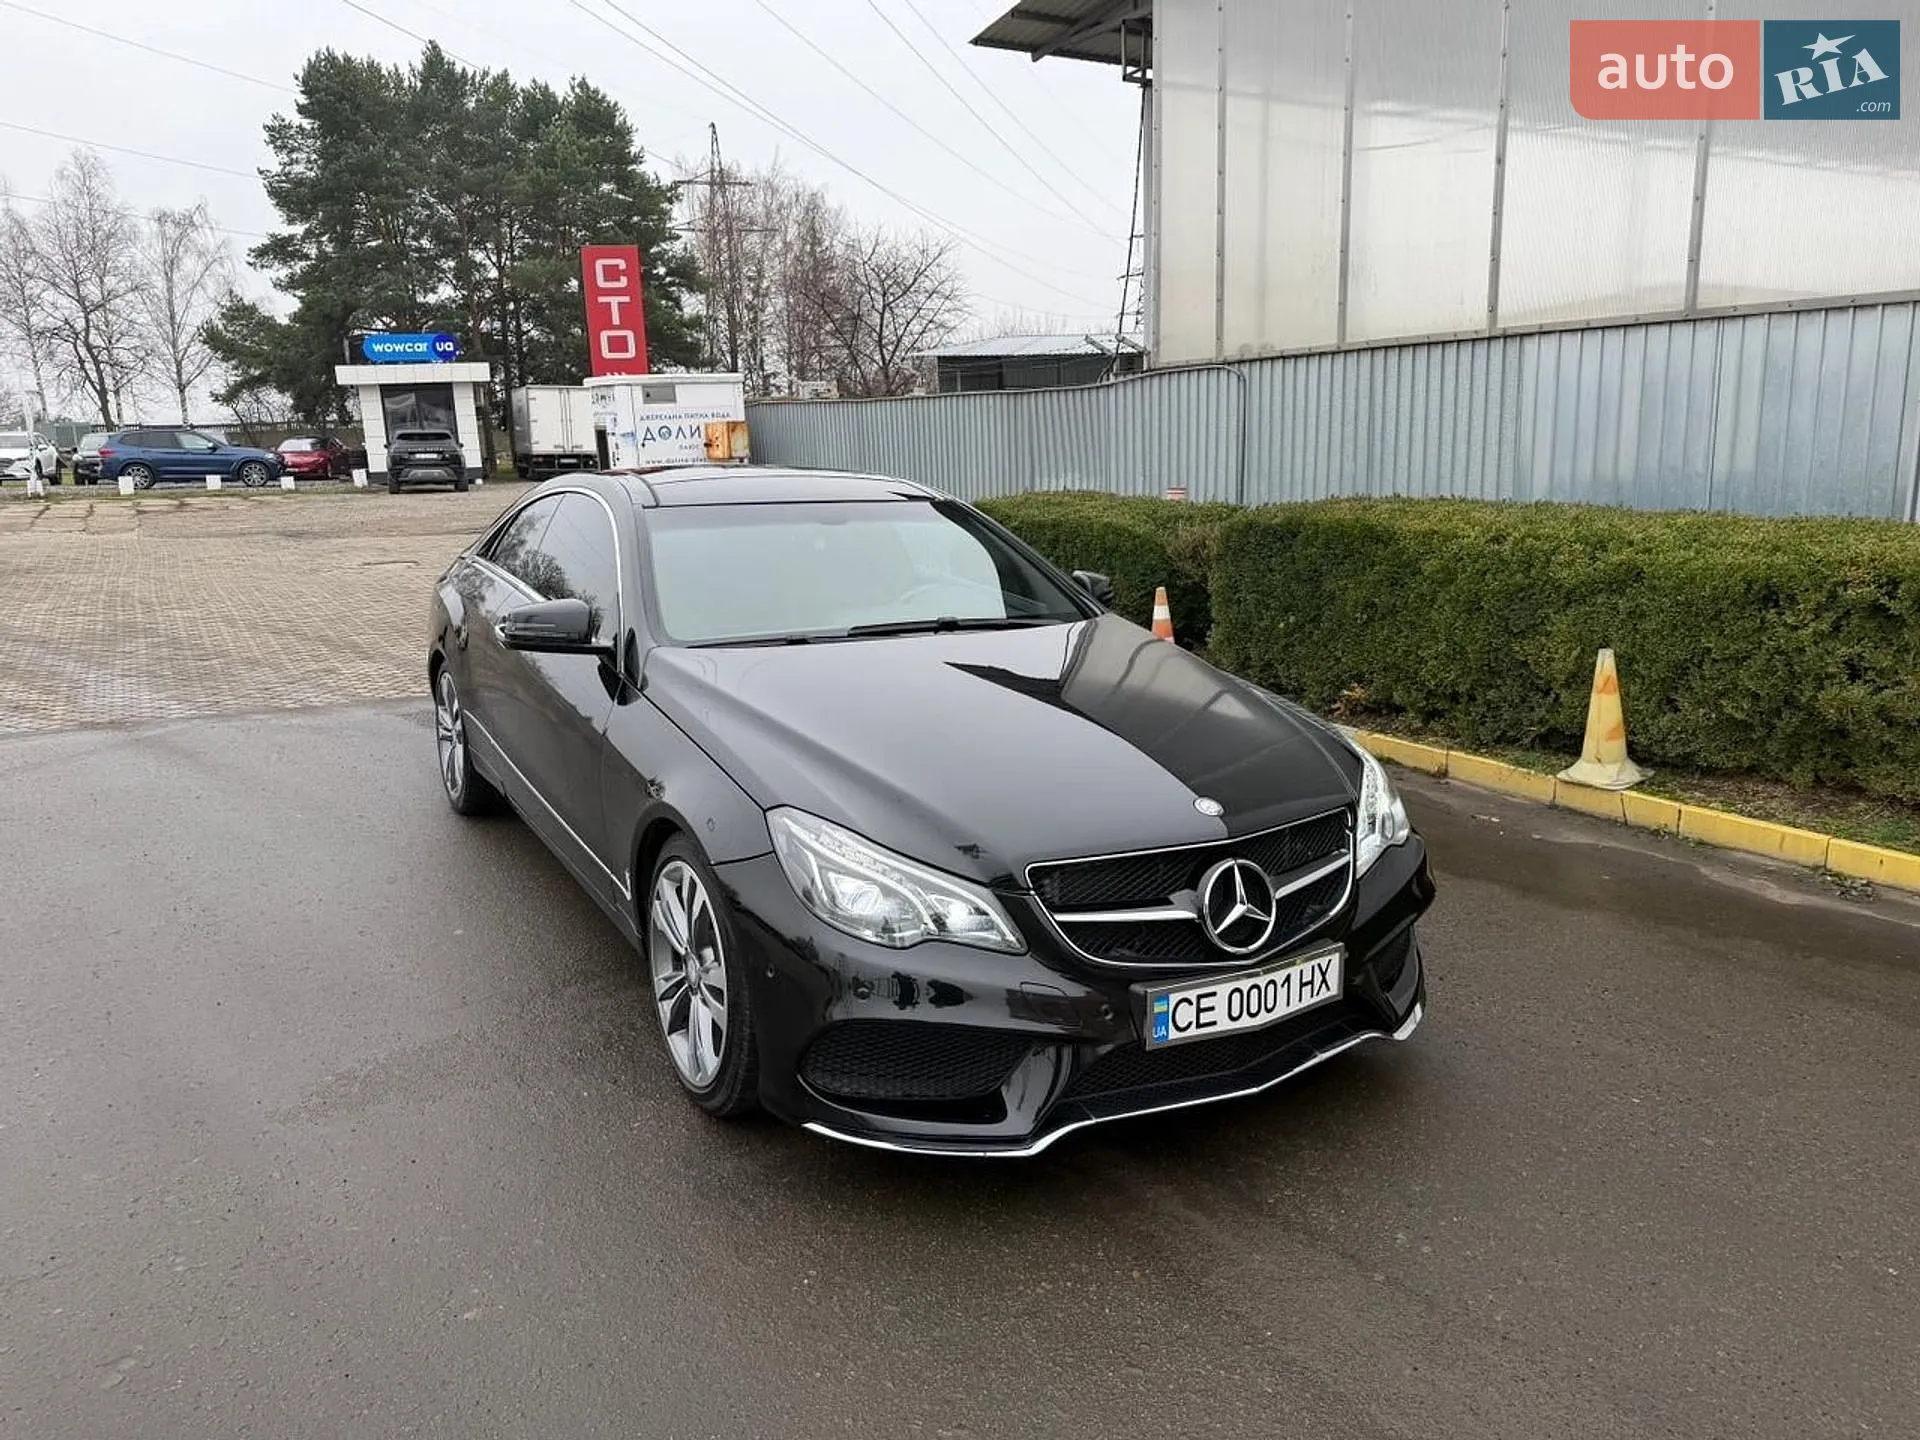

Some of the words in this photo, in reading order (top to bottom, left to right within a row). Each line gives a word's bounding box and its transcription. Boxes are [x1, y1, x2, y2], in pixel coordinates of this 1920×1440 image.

[595, 258, 637, 359] СТО
[372, 341, 428, 353] wowcar
[435, 341, 454, 352] ua
[642, 424, 702, 443] ДОЛИ
[1171, 991, 1218, 1033] CE
[1227, 973, 1292, 1022] 0001
[1299, 958, 1333, 1003] HX
[1152, 1025, 1168, 1038] UA
